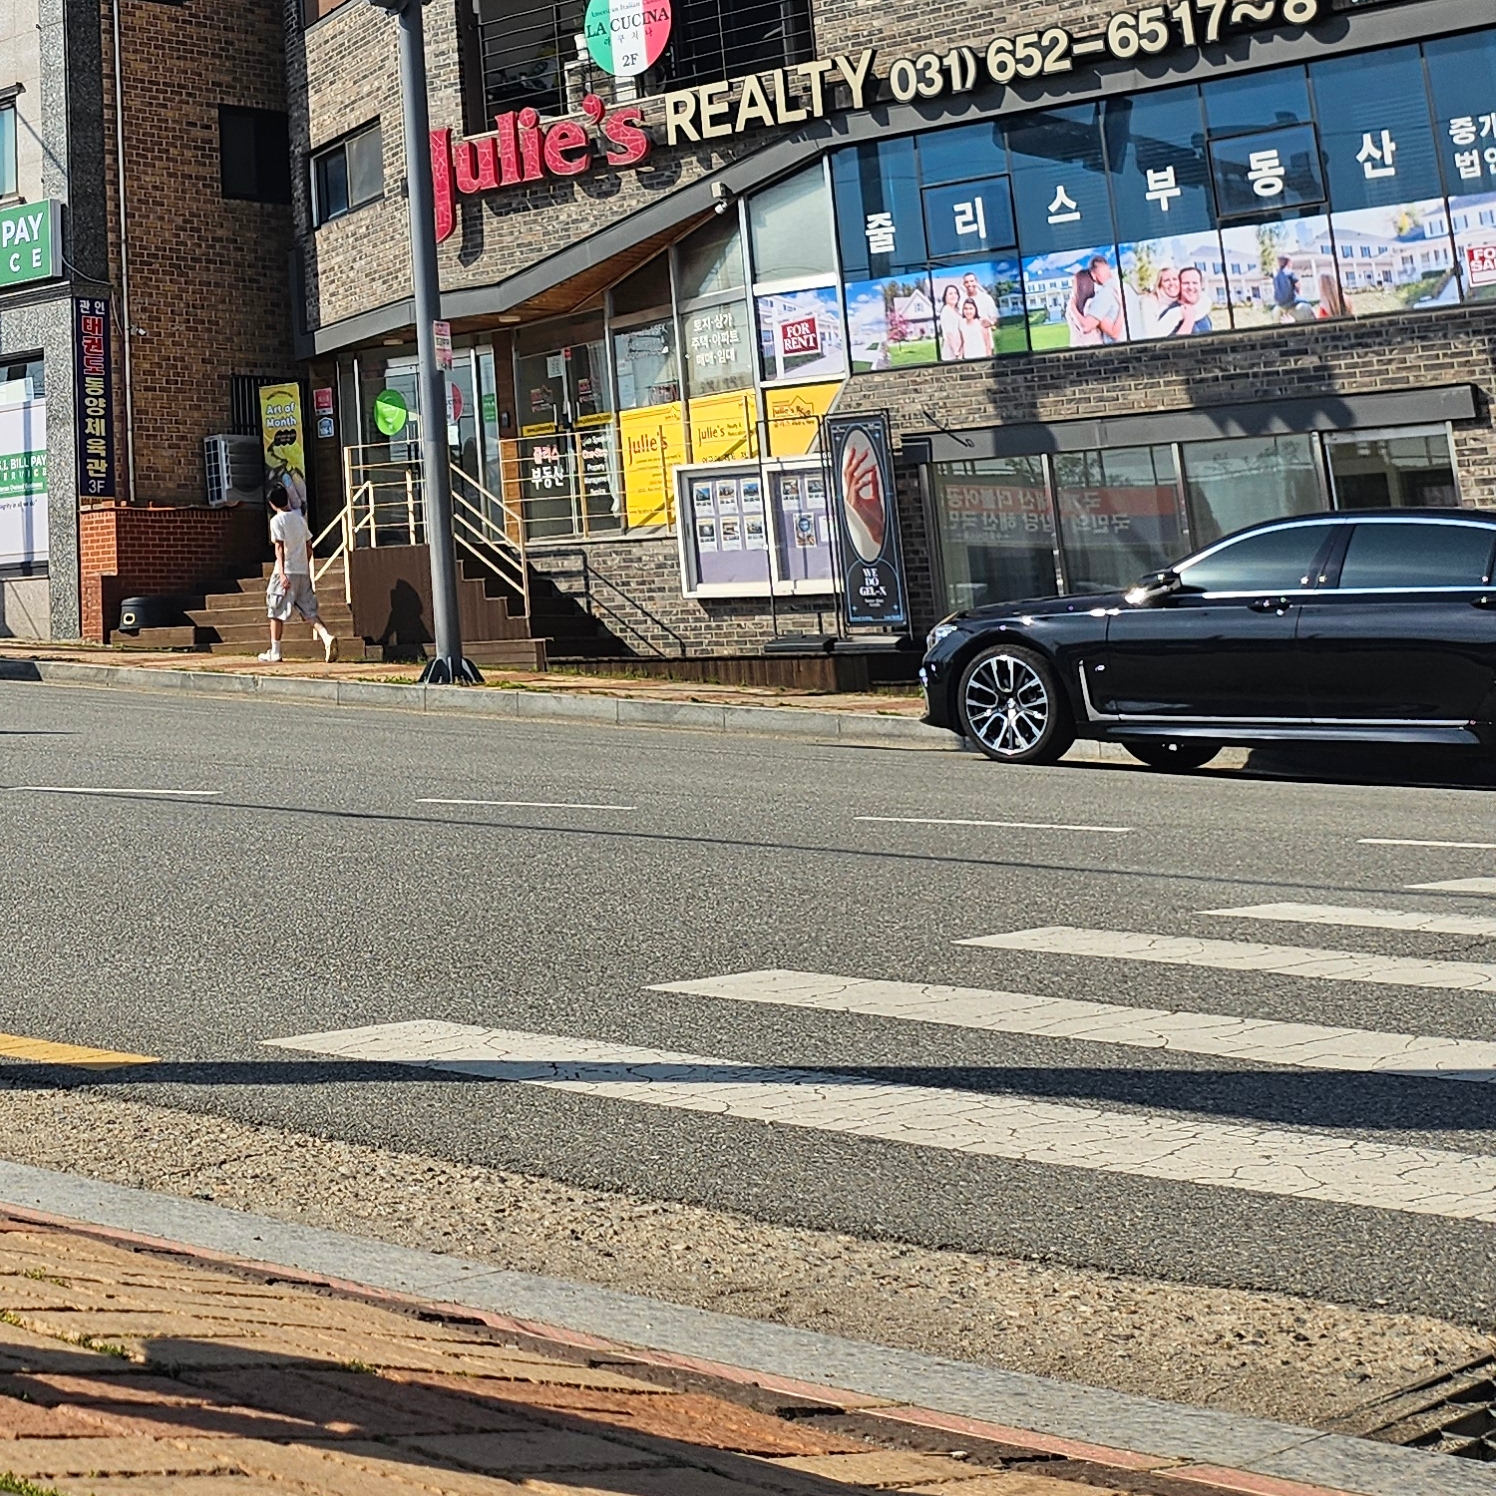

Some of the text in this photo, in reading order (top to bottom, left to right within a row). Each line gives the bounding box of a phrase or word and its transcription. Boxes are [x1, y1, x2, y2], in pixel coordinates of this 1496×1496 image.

[619, 2, 641, 11] Italian
[586, 7, 670, 39] LA CUCINA
[622, 53, 639, 67] 2F
[429, 92, 651, 244] Julie's
[665, 48, 876, 146] REALTY
[890, 46, 978, 103] 031)
[1, 212, 44, 248] PAY
[79, 299, 106, 315] 관인
[786, 321, 811, 339] FOR
[81, 316, 106, 376] 태권도
[783, 333, 817, 353] RENT
[266, 402, 295, 415] Art of
[266, 416, 297, 428] Month
[697, 425, 726, 447] Julie's
[627, 432, 669, 467] Julie's
[10, 456, 30, 470] BILL
[30, 454, 47, 467] PAY
[531, 465, 564, 490] 부동산
[88, 479, 106, 494] 3F
[862, 568, 879, 577] WE
[865, 577, 880, 587] DO
[859, 586, 887, 597] GEL-X
